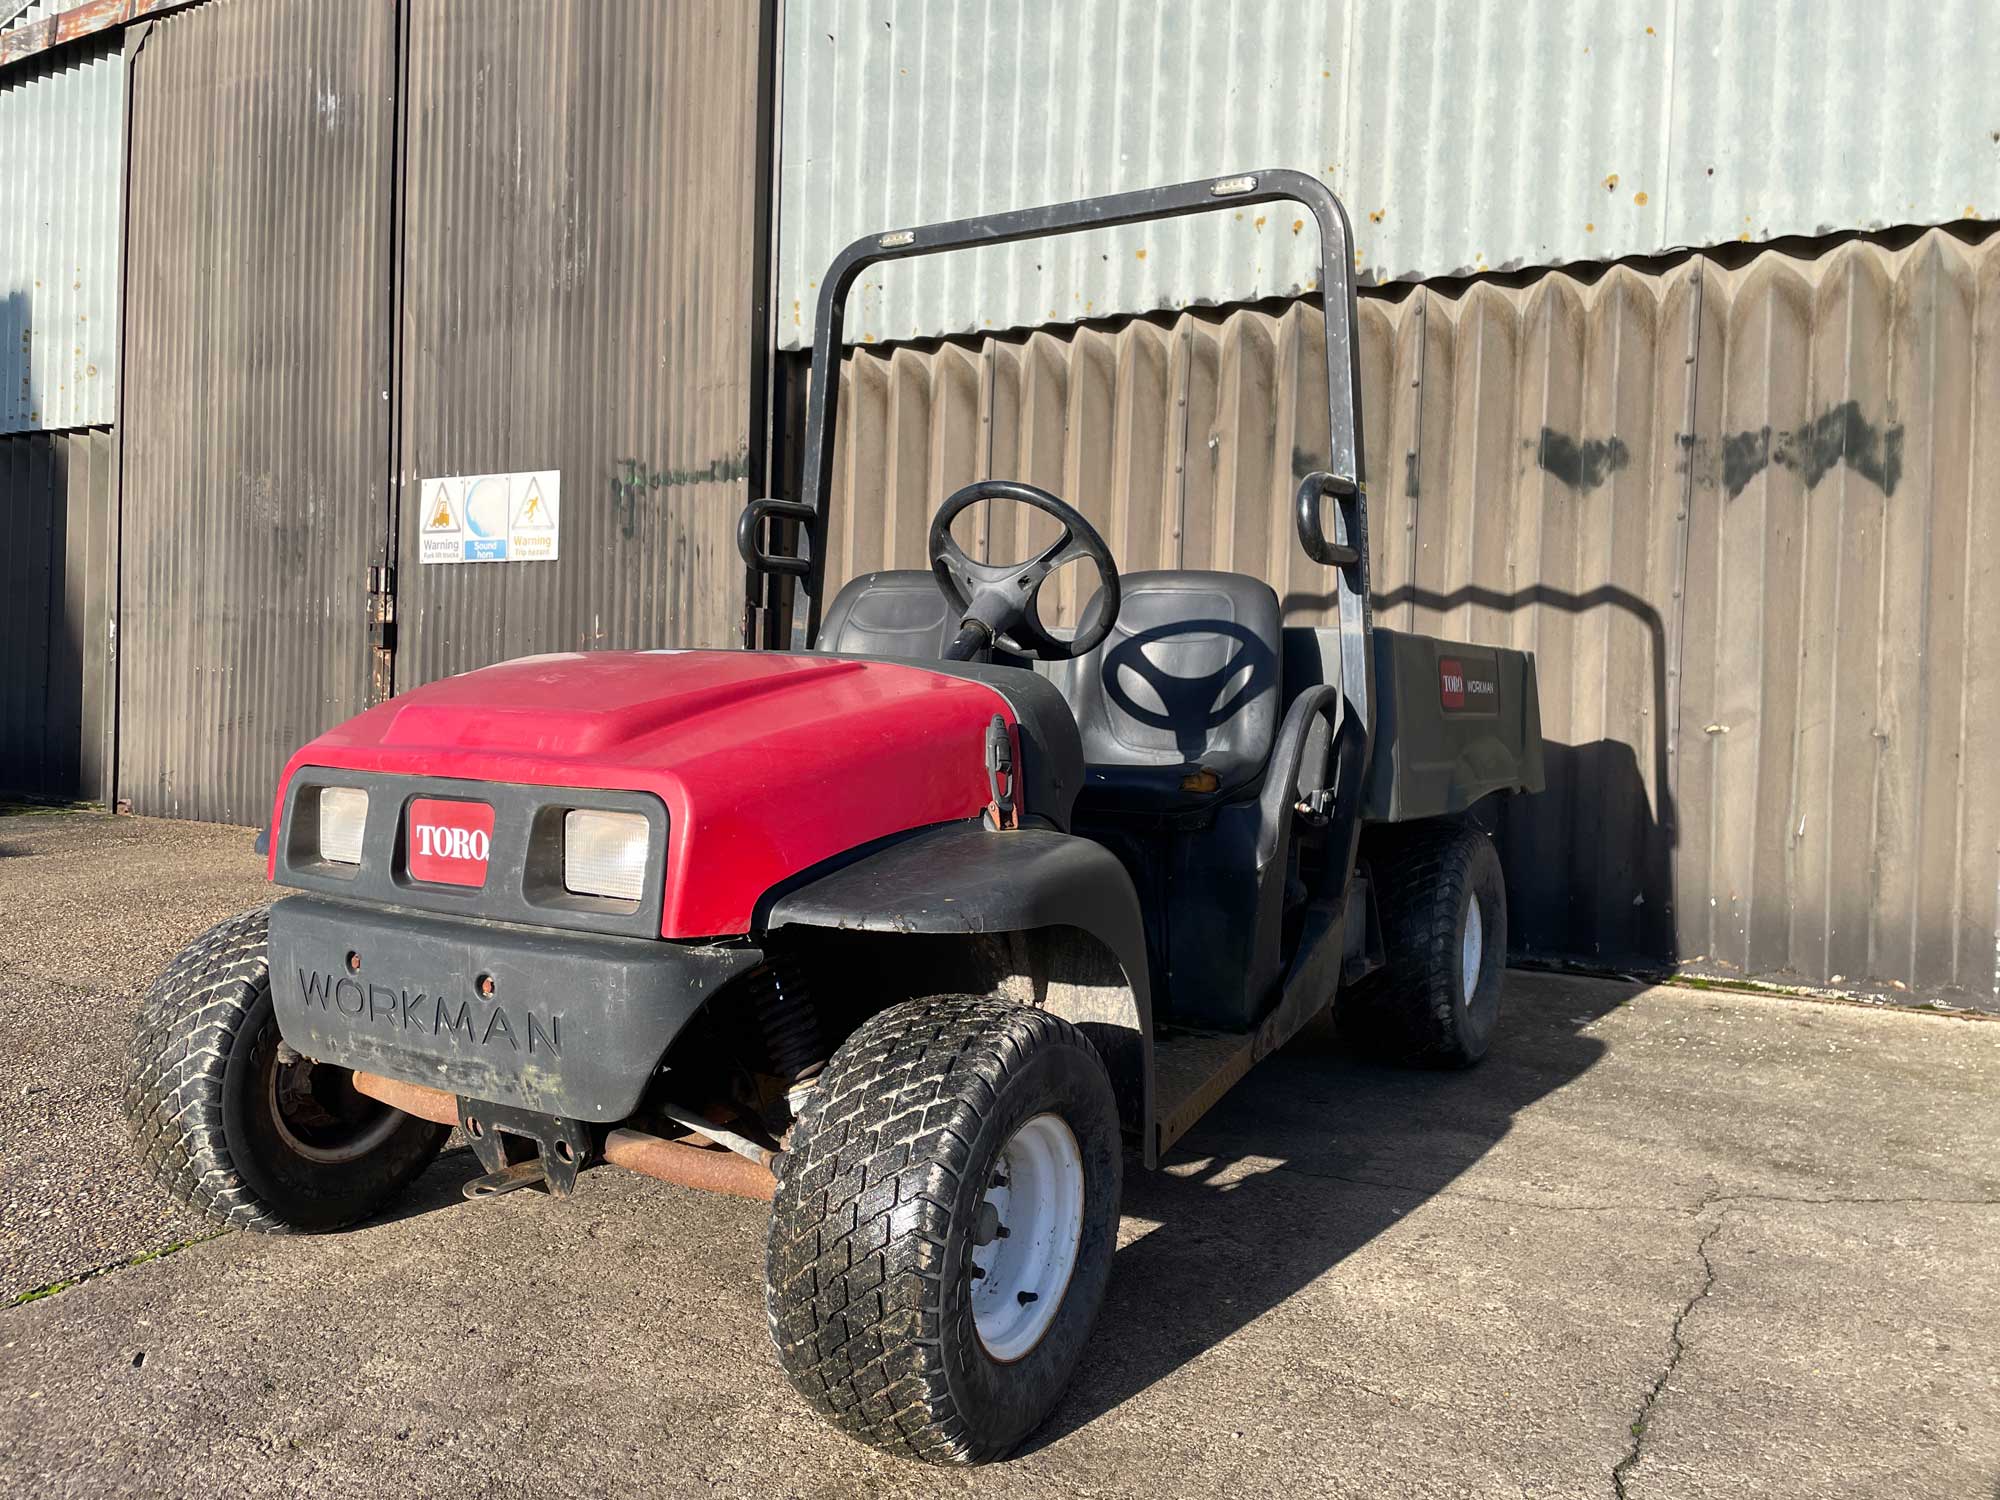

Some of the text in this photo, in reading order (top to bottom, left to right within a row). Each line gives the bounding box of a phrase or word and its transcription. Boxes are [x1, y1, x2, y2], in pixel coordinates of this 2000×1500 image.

[424, 538, 459, 552] Warning
[474, 541, 497, 551] Sound
[513, 535, 552, 548] Warning
[476, 550, 494, 559] horn
[1442, 675, 1494, 694] TORO WORKMAN
[416, 824, 490, 861] TORO
[298, 967, 563, 1060] WORKMAN
